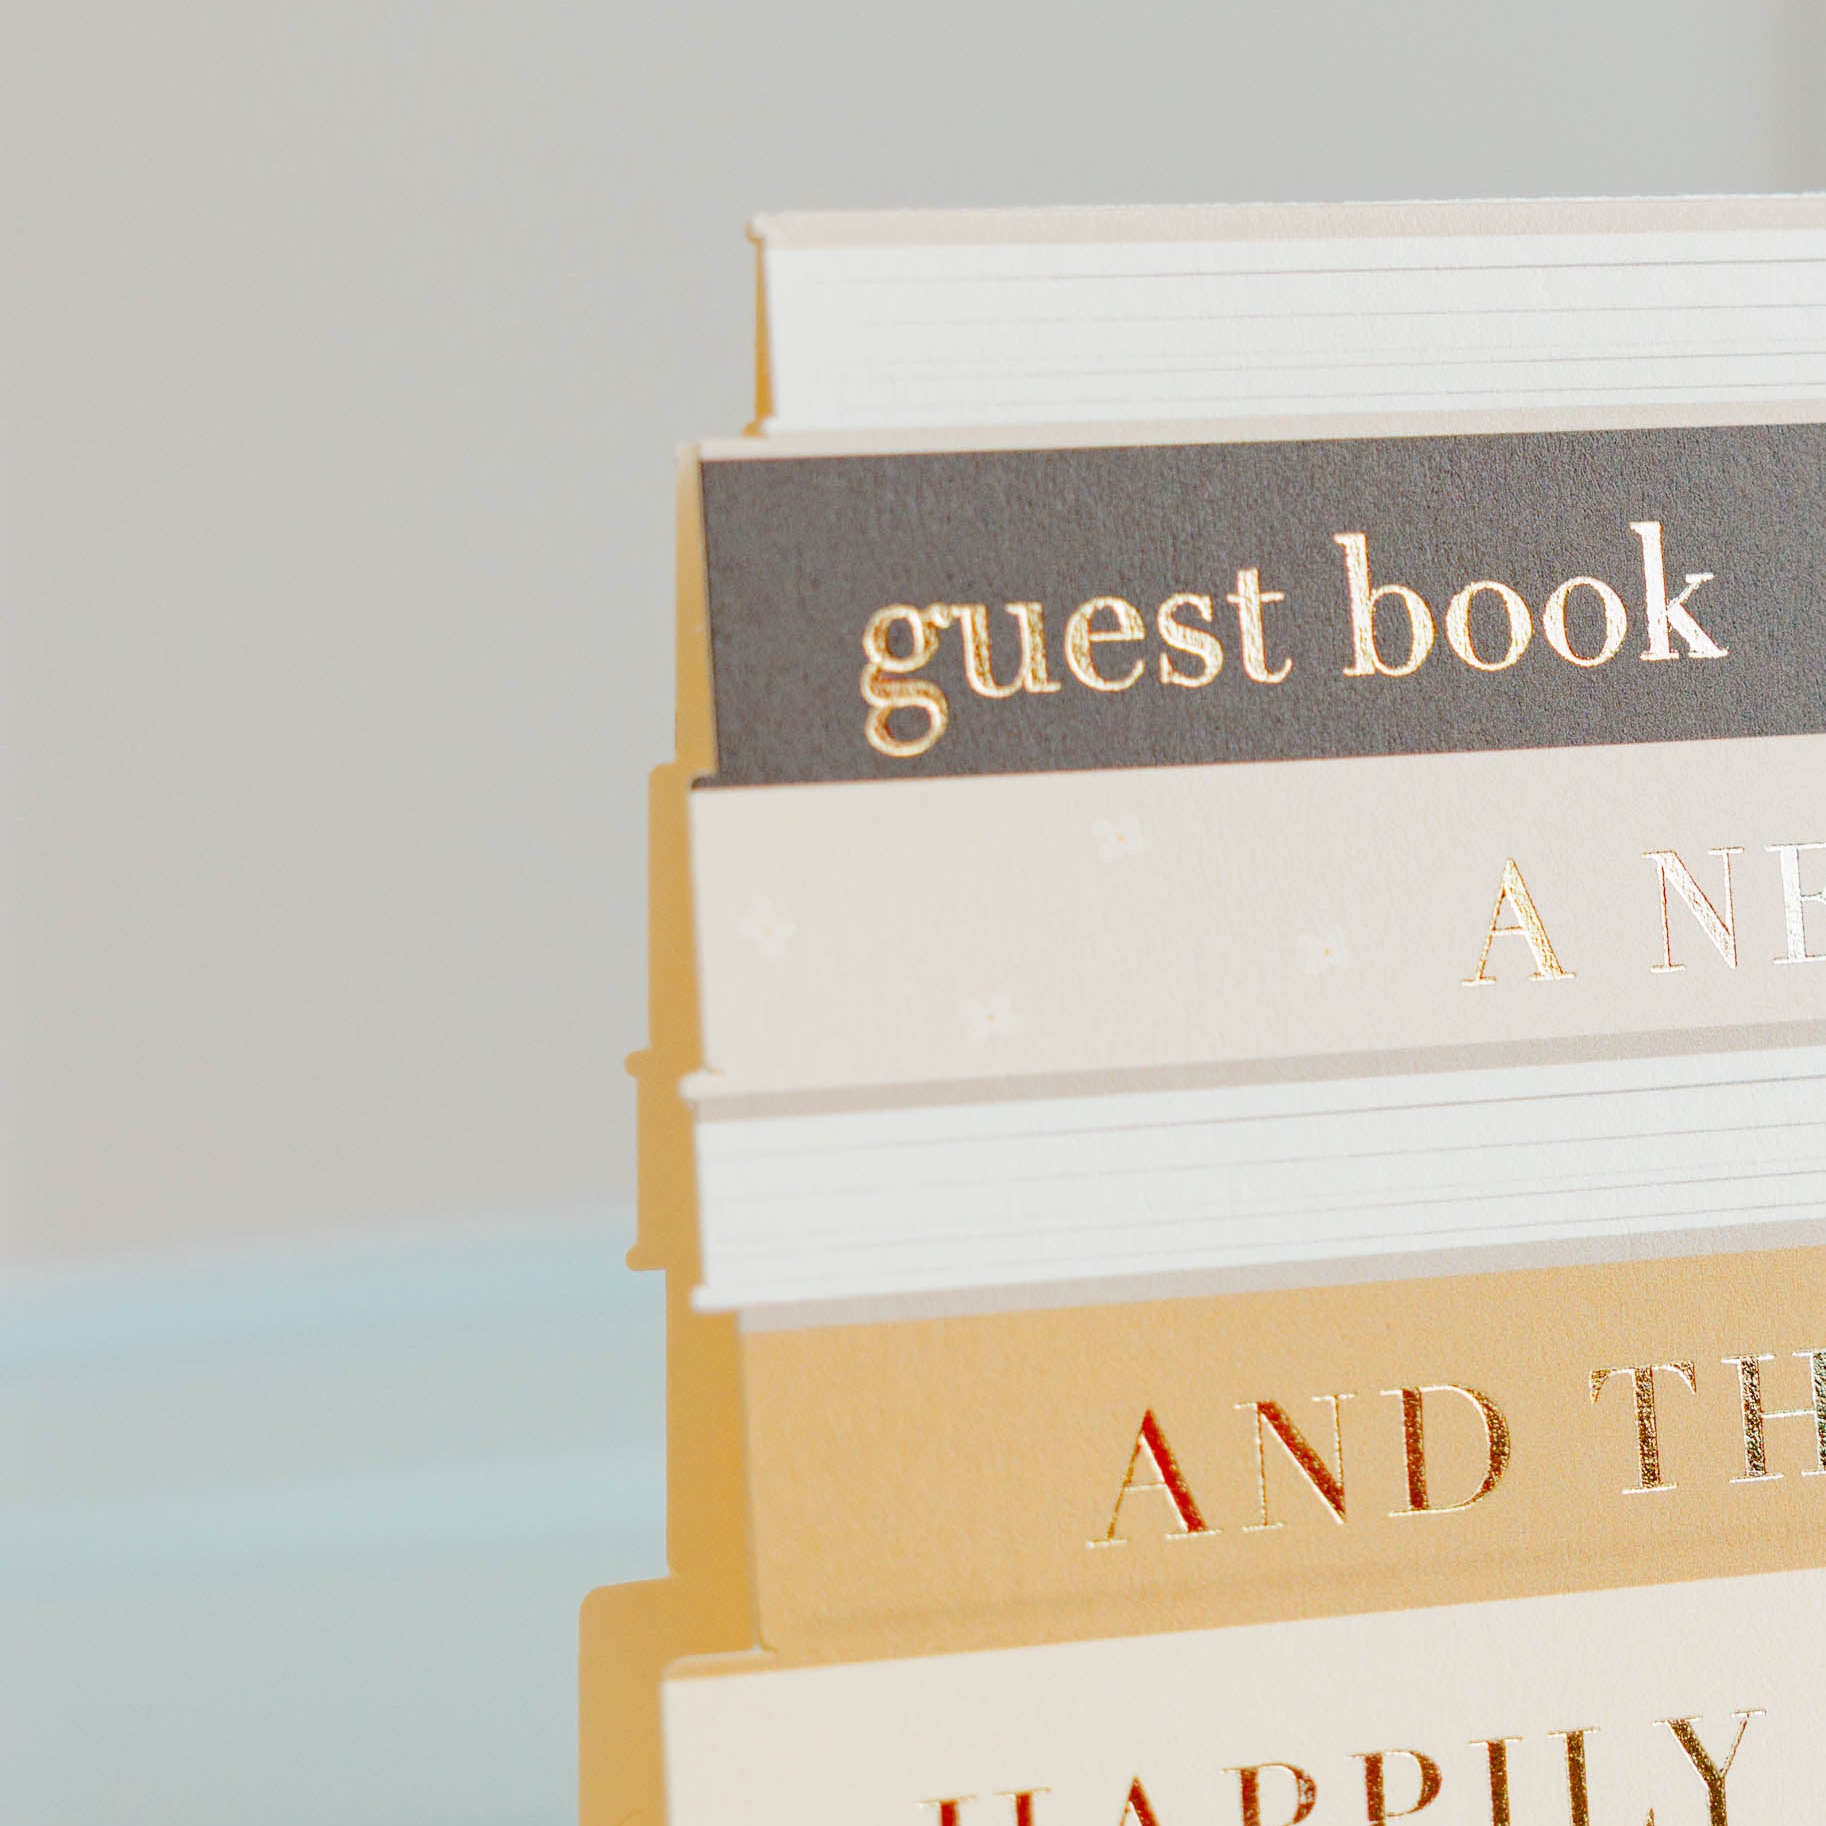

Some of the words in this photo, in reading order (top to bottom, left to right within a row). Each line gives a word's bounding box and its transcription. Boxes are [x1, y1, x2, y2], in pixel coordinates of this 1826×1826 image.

[857, 568, 1292, 756] guest
[1333, 521, 1728, 676] book
[1461, 858, 1575, 987] A
[1086, 1382, 1513, 1546] AND
